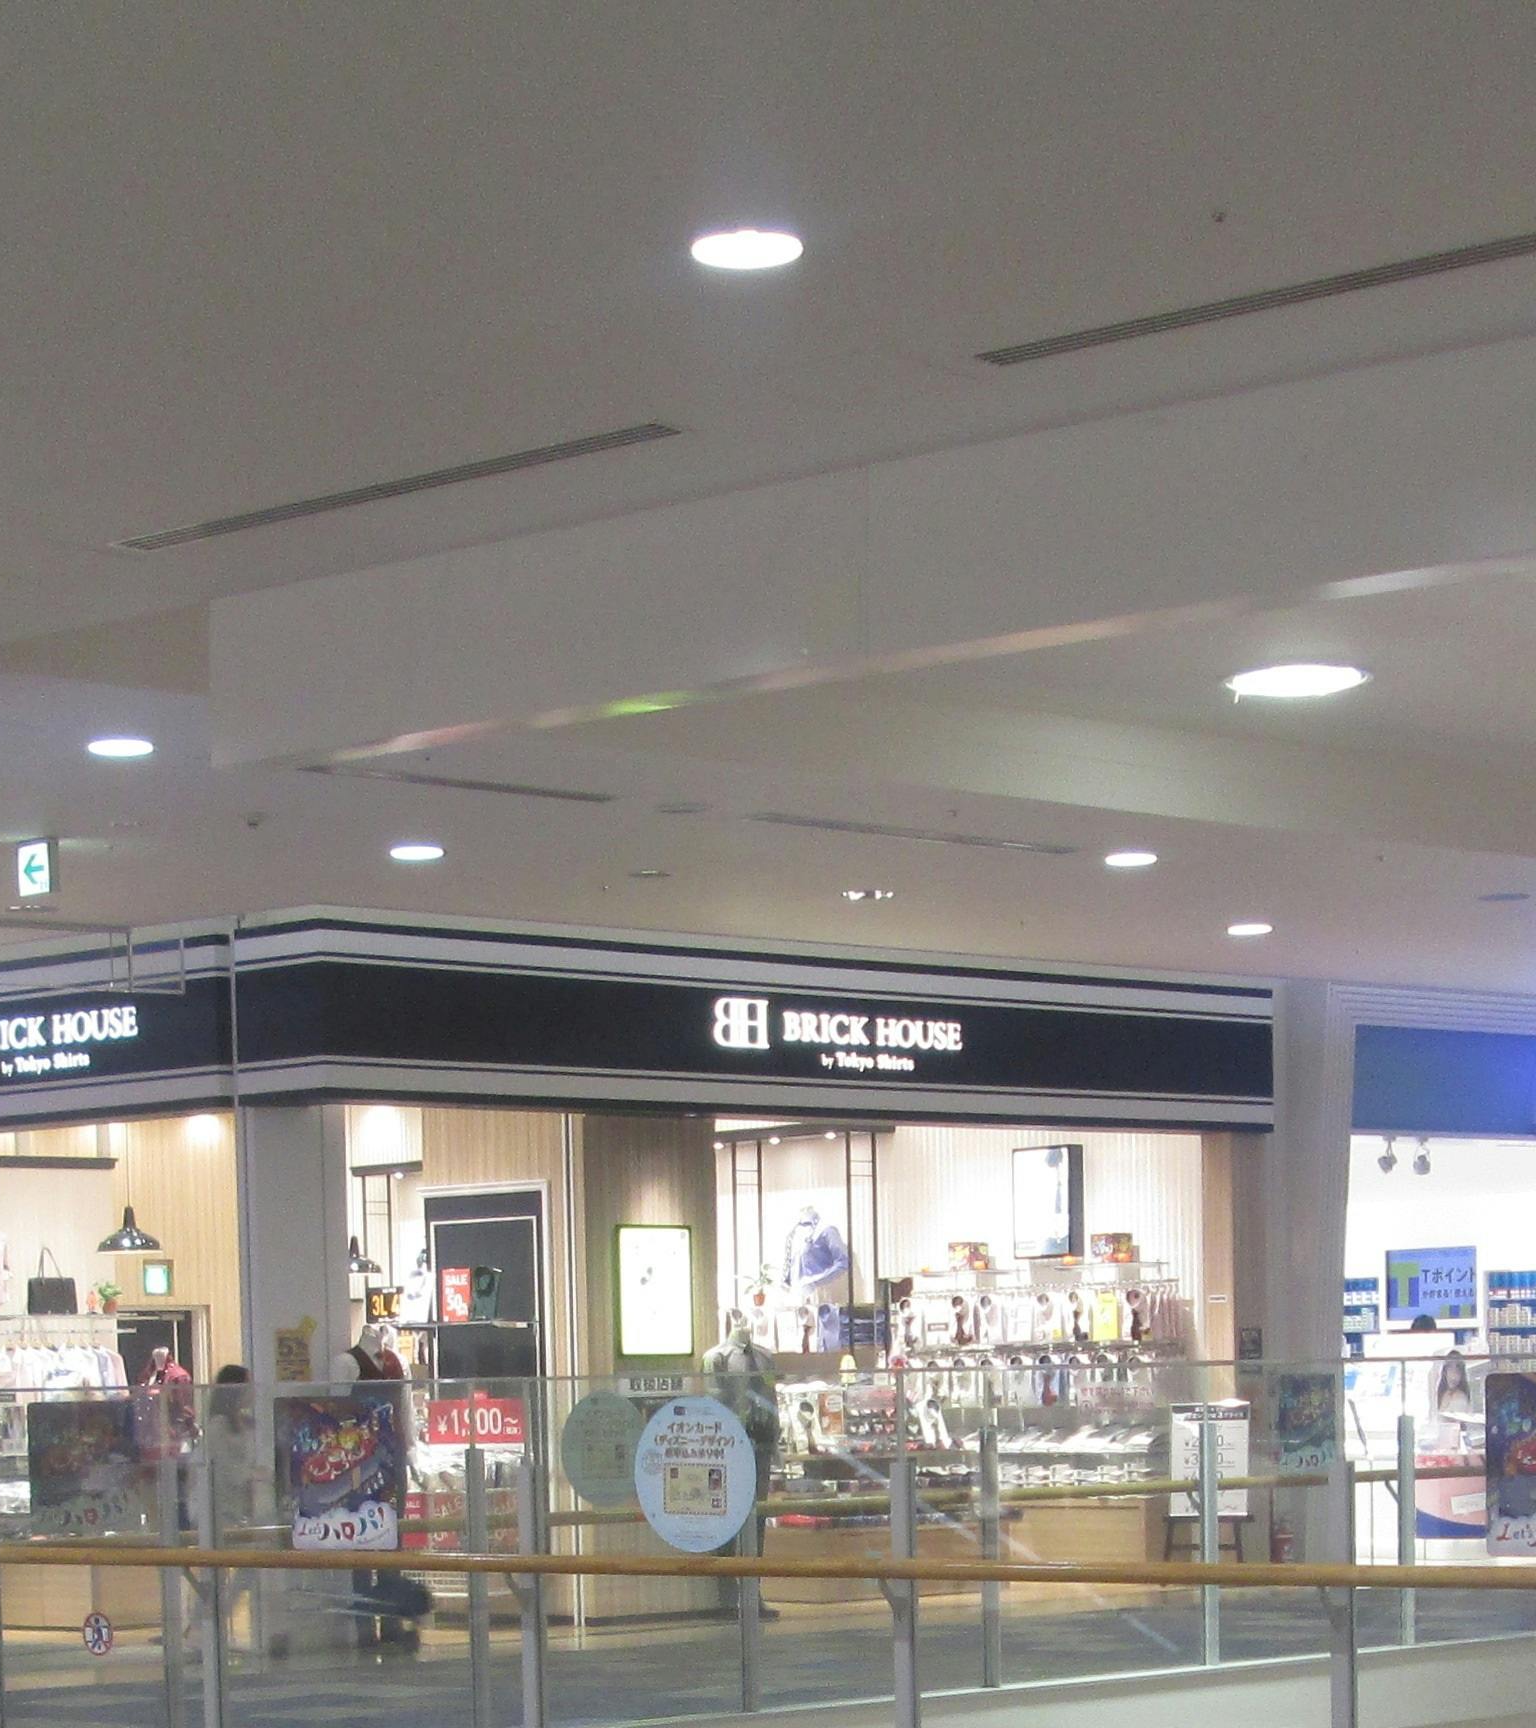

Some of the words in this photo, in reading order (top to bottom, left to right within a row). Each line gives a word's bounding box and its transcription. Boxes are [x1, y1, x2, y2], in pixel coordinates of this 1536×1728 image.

[52, 1006, 139, 1044] HOUSE
[782, 1011, 870, 1046] BRICK
[876, 1017, 963, 1051] HOUSE
[1, 1061, 14, 1077] by
[14, 1055, 51, 1075] Tokyo
[52, 1053, 91, 1069] Shirts
[820, 1054, 834, 1069] by
[835, 1052, 875, 1072] Tokyo
[876, 1053, 915, 1071] Shirts
[667, 1421, 722, 1434] イオンカード
